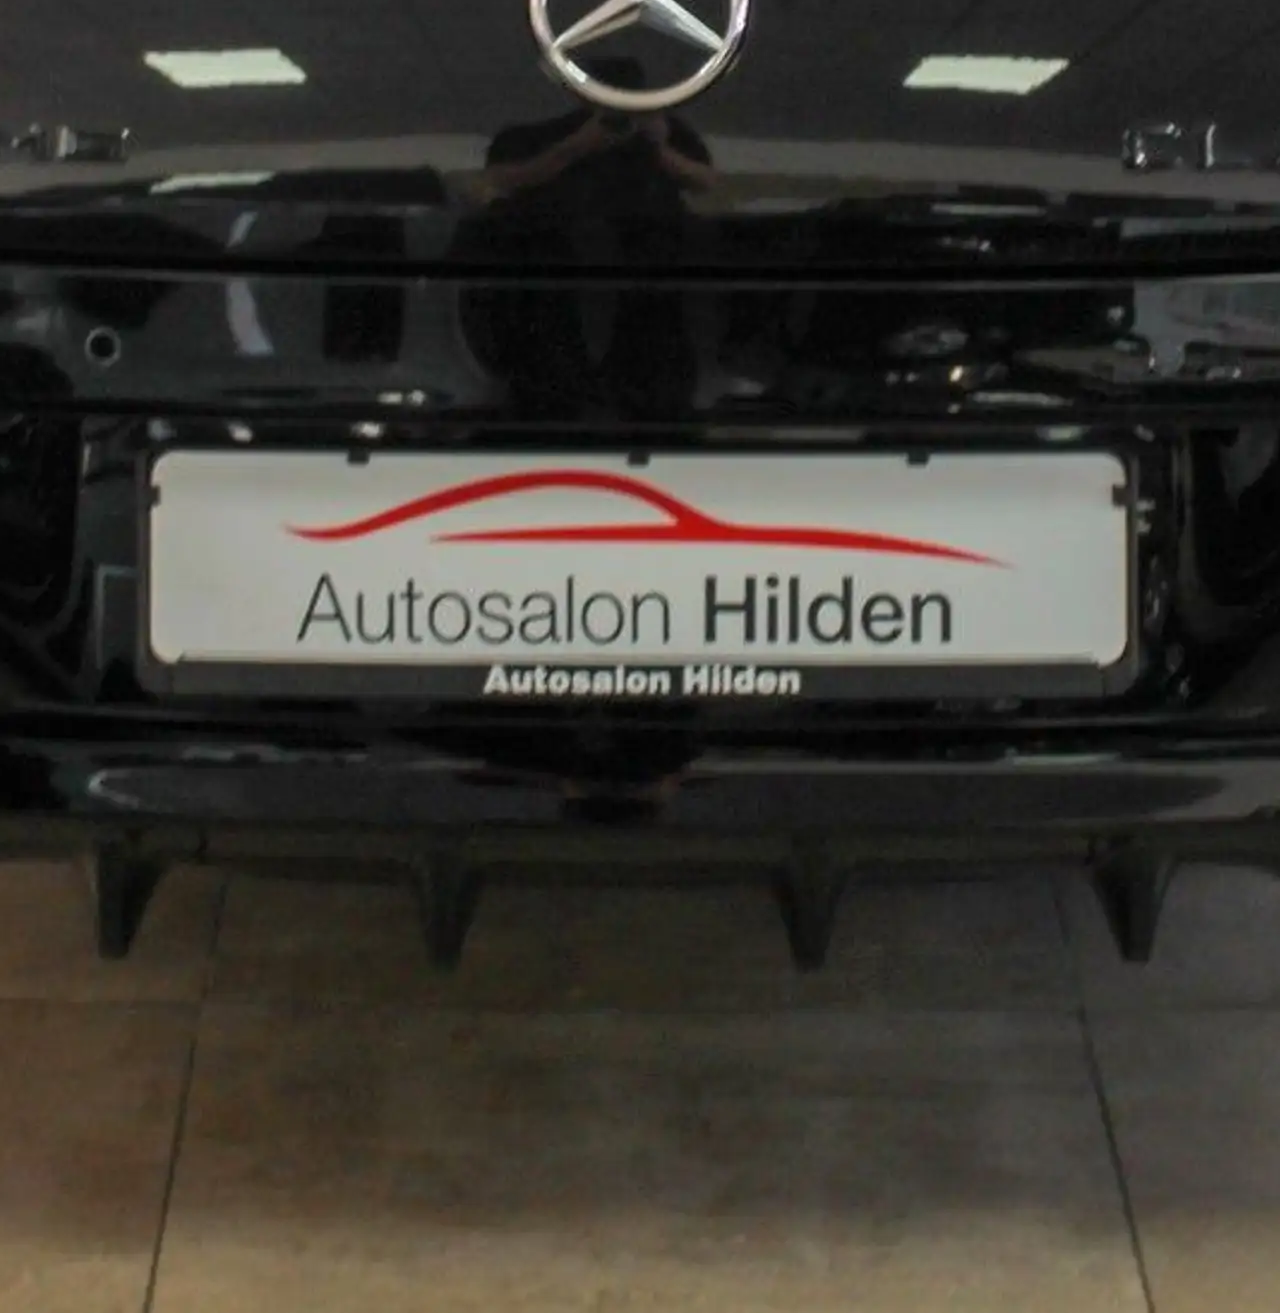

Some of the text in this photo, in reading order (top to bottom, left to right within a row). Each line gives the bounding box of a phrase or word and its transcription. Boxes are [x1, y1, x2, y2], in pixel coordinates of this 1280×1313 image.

[296, 572, 953, 645] Autosalon Hilden
[482, 664, 803, 696] Autosalon Hilden
